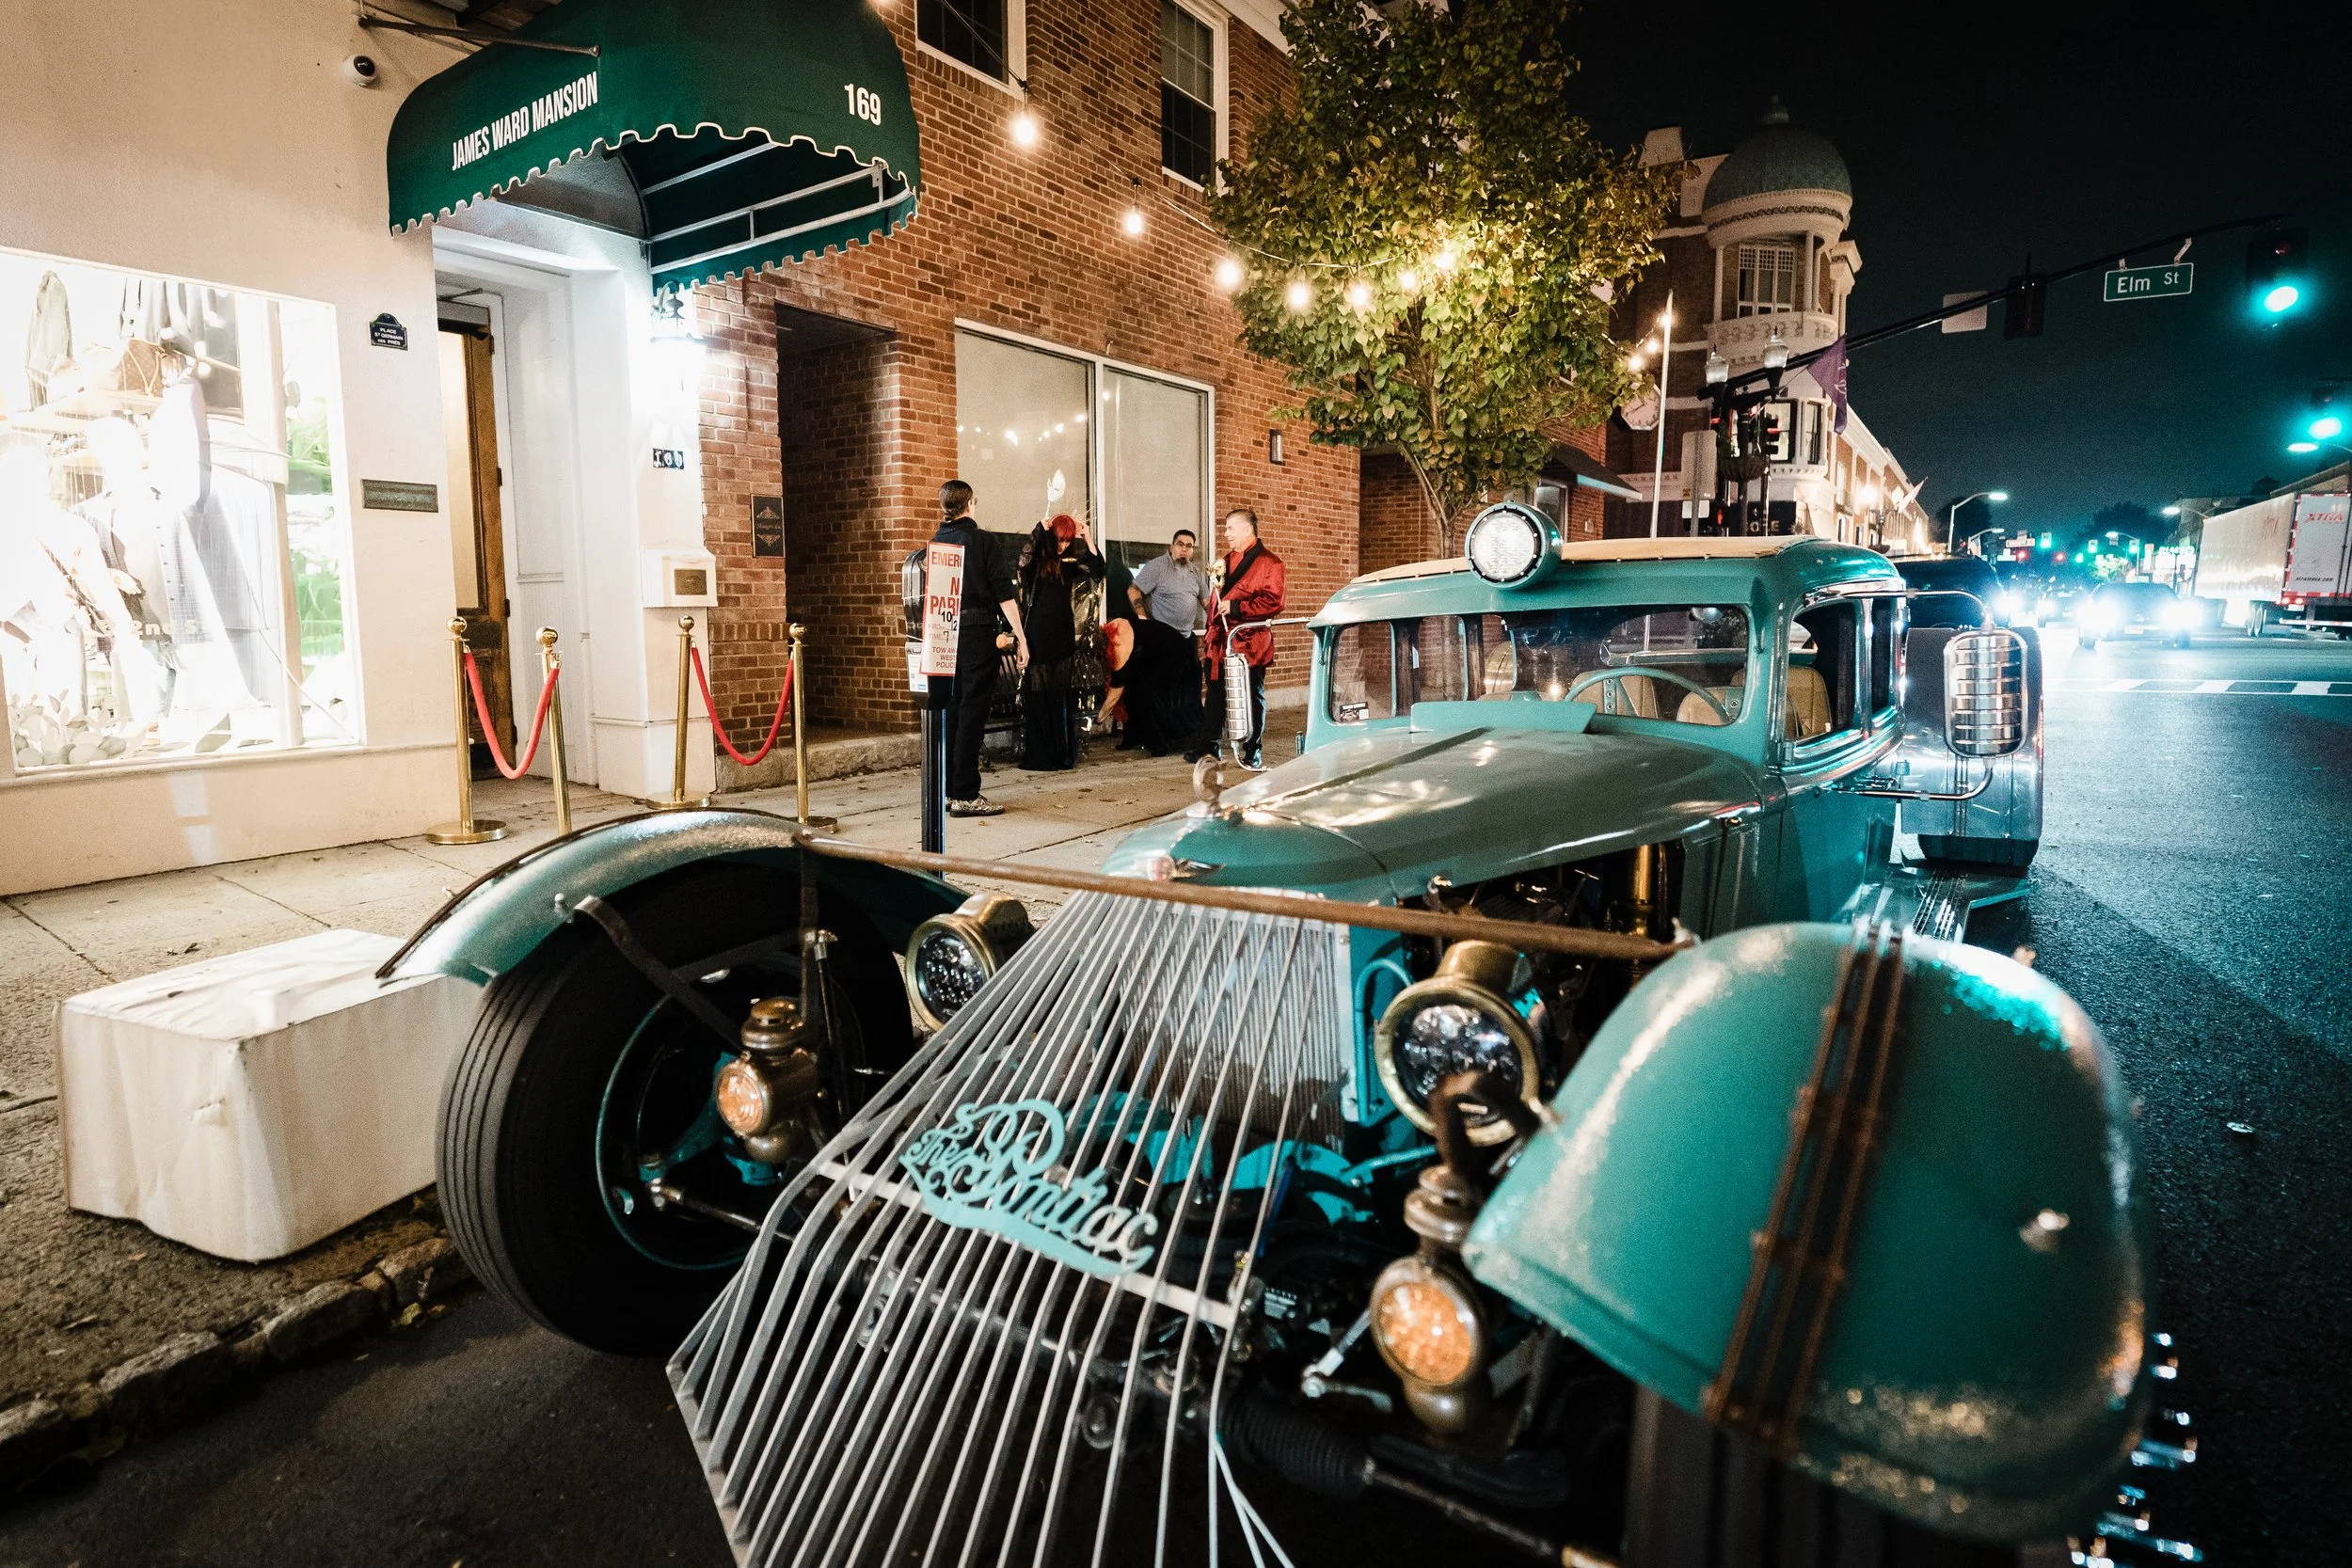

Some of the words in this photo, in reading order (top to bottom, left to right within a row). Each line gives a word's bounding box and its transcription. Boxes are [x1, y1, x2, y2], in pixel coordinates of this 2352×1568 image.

[844, 83, 882, 126] 169
[452, 125, 490, 171] JAMES
[491, 105, 530, 151] WARD
[532, 71, 598, 133] MANSION
[2117, 276, 2151, 293] Elm
[2164, 271, 2180, 285] St
[654, 450, 683, 468] 169
[930, 595, 960, 616] PAR
[941, 610, 952, 623] 10
[943, 631, 949, 643] 7
